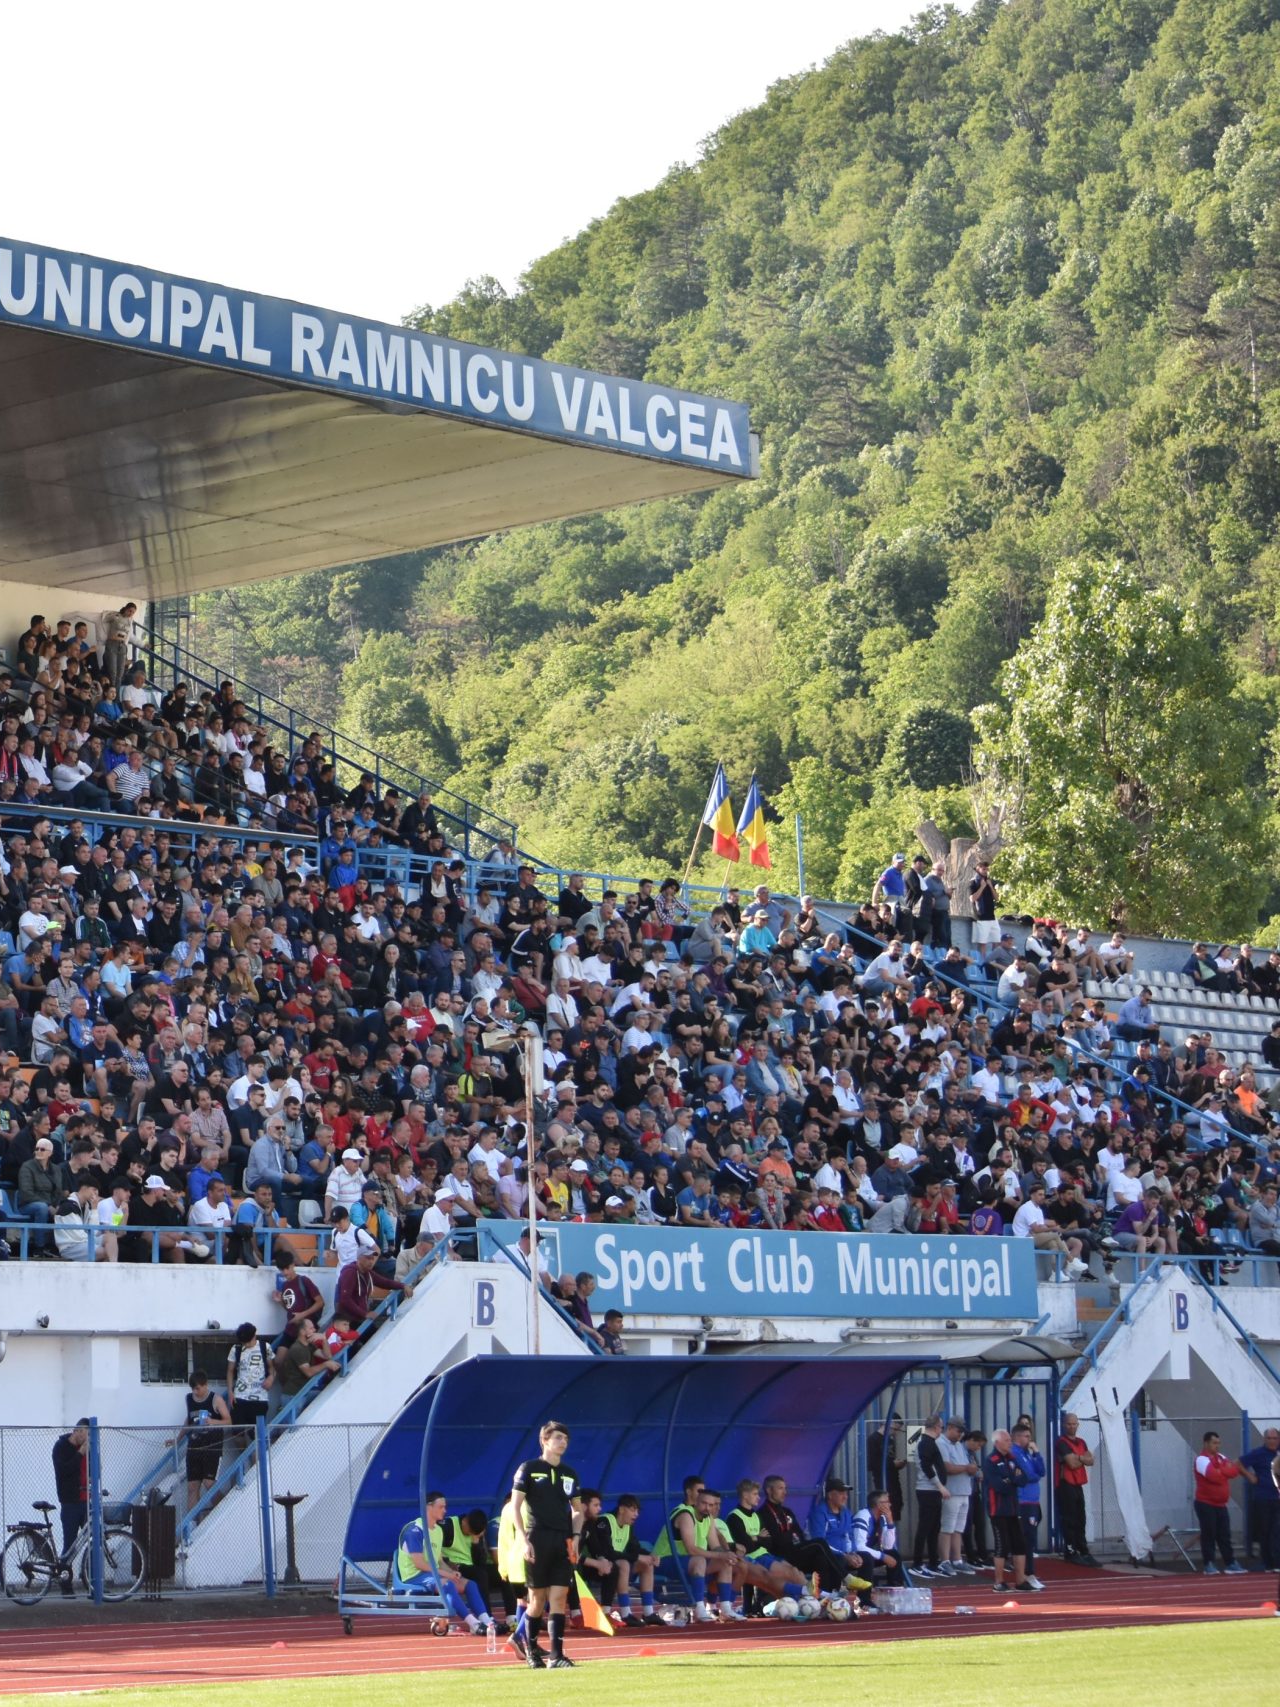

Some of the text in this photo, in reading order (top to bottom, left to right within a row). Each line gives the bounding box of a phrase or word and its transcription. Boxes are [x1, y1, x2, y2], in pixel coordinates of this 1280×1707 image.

[291, 312, 534, 422] RAMNICU
[551, 371, 741, 466] VALCEA
[476, 1281, 495, 1326] B
[595, 1233, 1011, 1312] Sport Club Municipal
[1175, 1292, 1189, 1331] B
